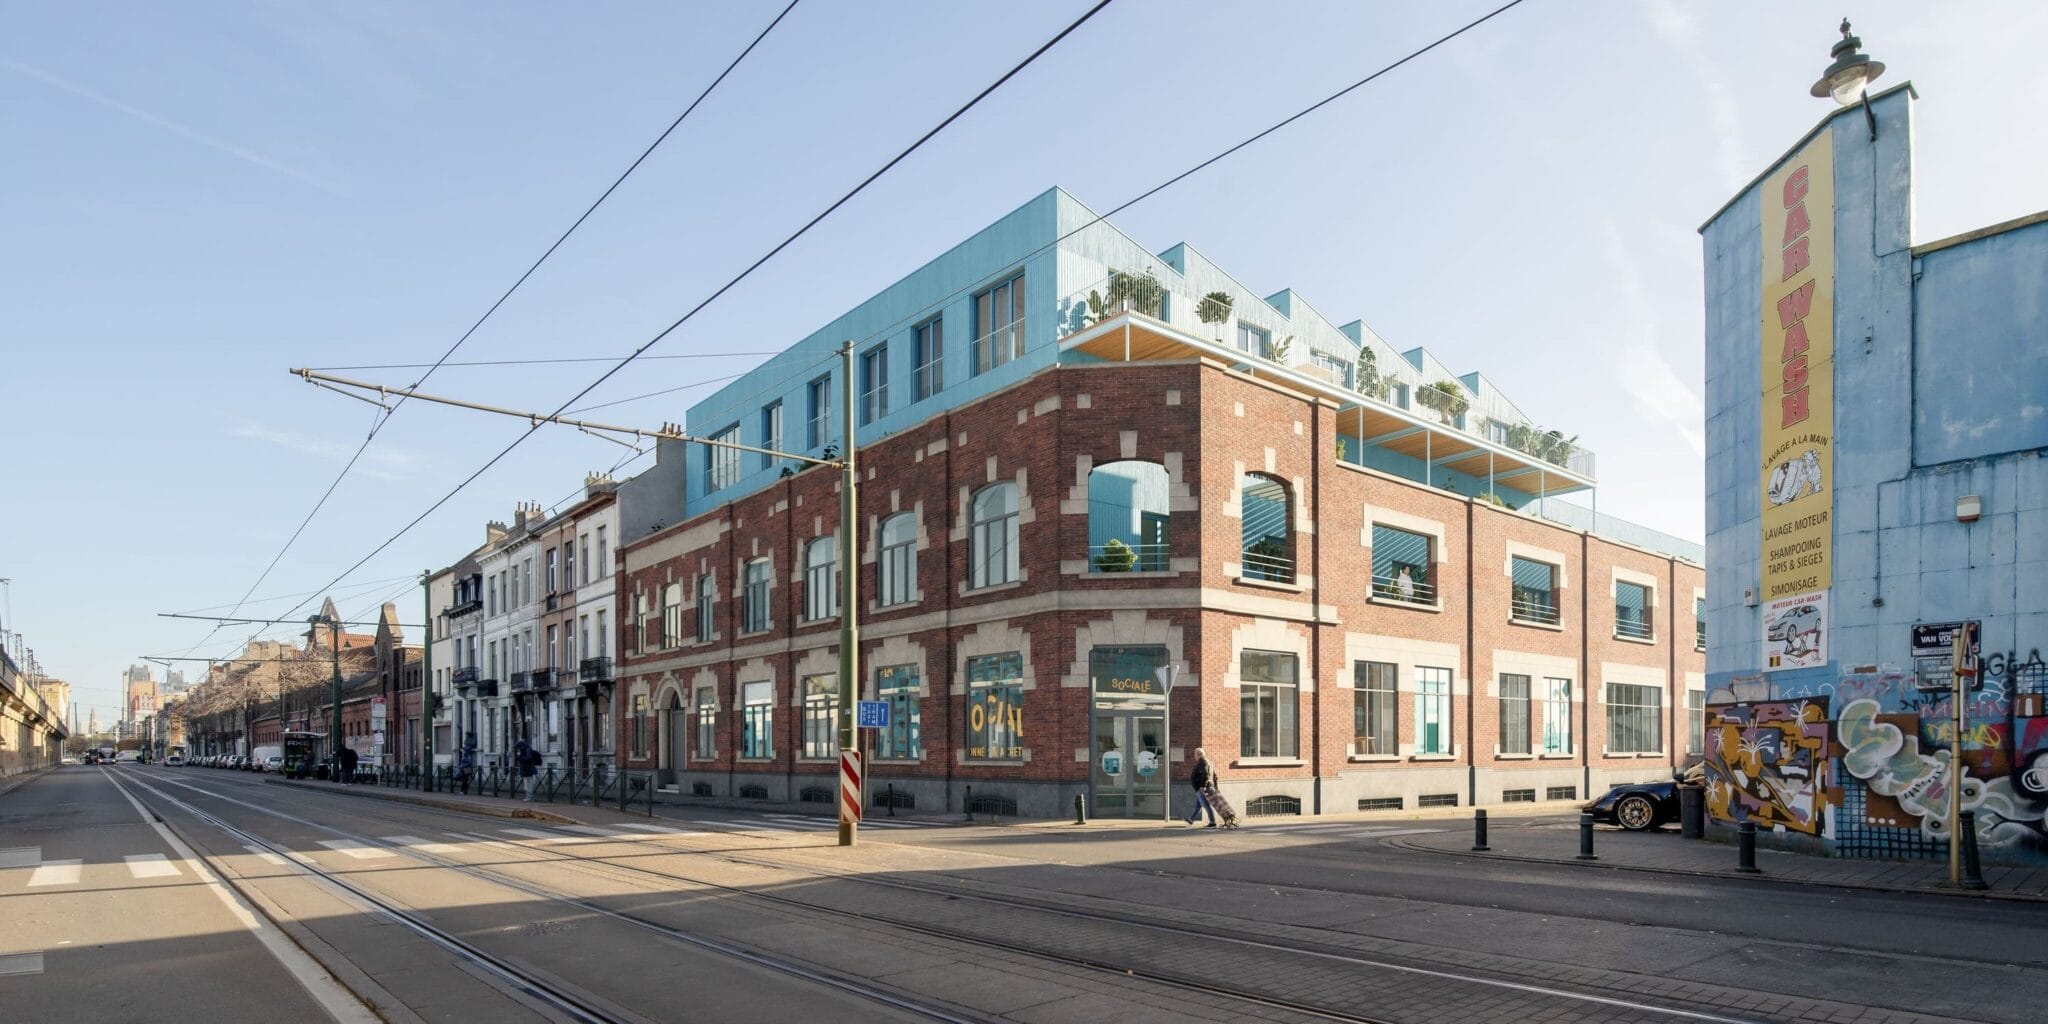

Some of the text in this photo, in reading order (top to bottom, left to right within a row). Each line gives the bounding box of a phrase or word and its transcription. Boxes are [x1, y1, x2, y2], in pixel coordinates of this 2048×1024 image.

[1777, 164, 1815, 430] CAR WASH
[1764, 441, 1790, 469] LAVAGE
[1798, 434, 1808, 444] LA
[1810, 433, 1828, 446] MAIN
[1765, 511, 1828, 541] LAVAGE MOTEUR
[1770, 537, 1822, 561] SHAMPOOING
[1768, 551, 1823, 575] TAPIS & SIEGES
[1771, 576, 1818, 597] SIMONISAGE
[1772, 594, 1822, 610] MOTEUR CAR-WASH
[1920, 634, 1953, 643] VAN VOL
[1111, 678, 1151, 693] SOCIALE
